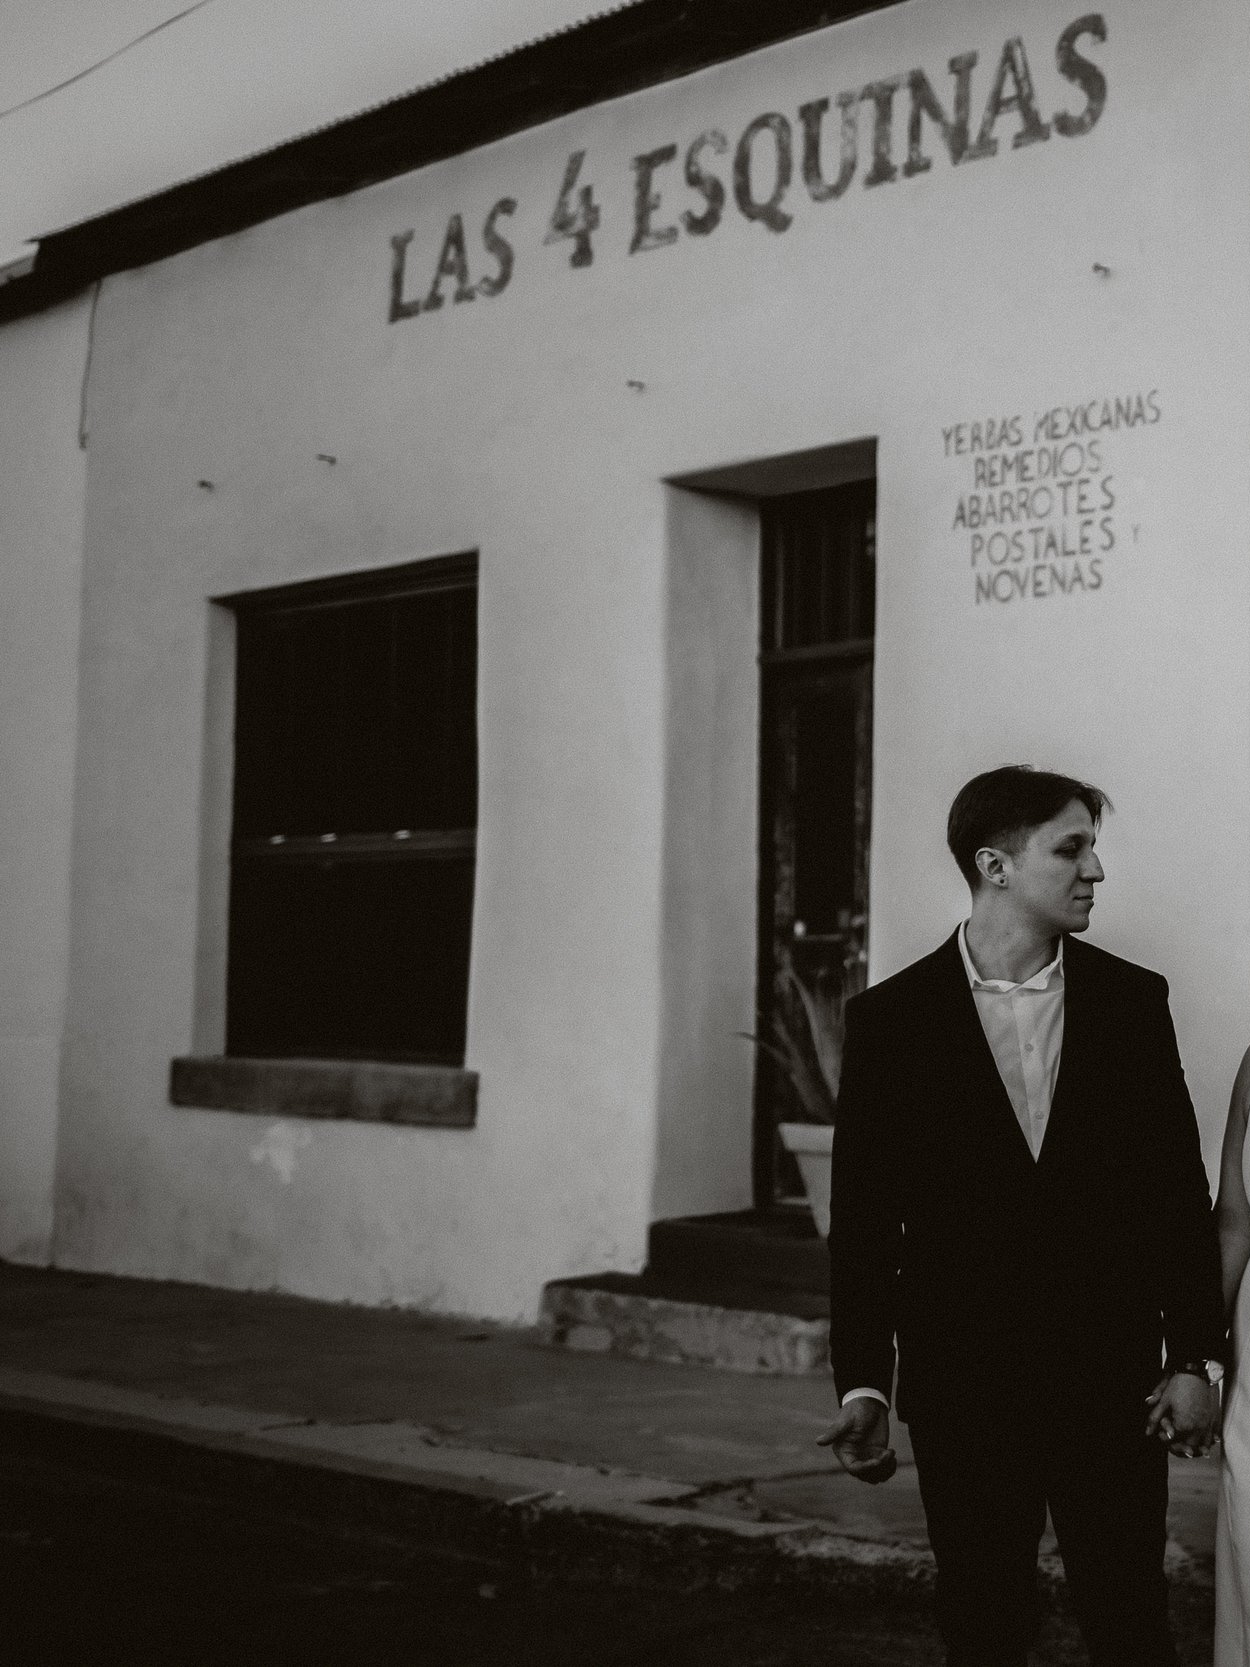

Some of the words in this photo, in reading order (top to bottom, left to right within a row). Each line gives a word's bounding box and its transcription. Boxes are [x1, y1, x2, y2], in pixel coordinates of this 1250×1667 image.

[388, 197, 517, 324] LAS
[542, 150, 602, 269] 4
[628, 13, 1109, 255] ESQUINAS
[941, 415, 1023, 457] YERBAS
[1033, 389, 1162, 443] MEXICANAS
[974, 440, 1101, 489] REMEDIOS
[953, 475, 1116, 530] ABARROTES
[971, 516, 1116, 567] POSTALES
[975, 558, 1102, 604] NOVENAS
